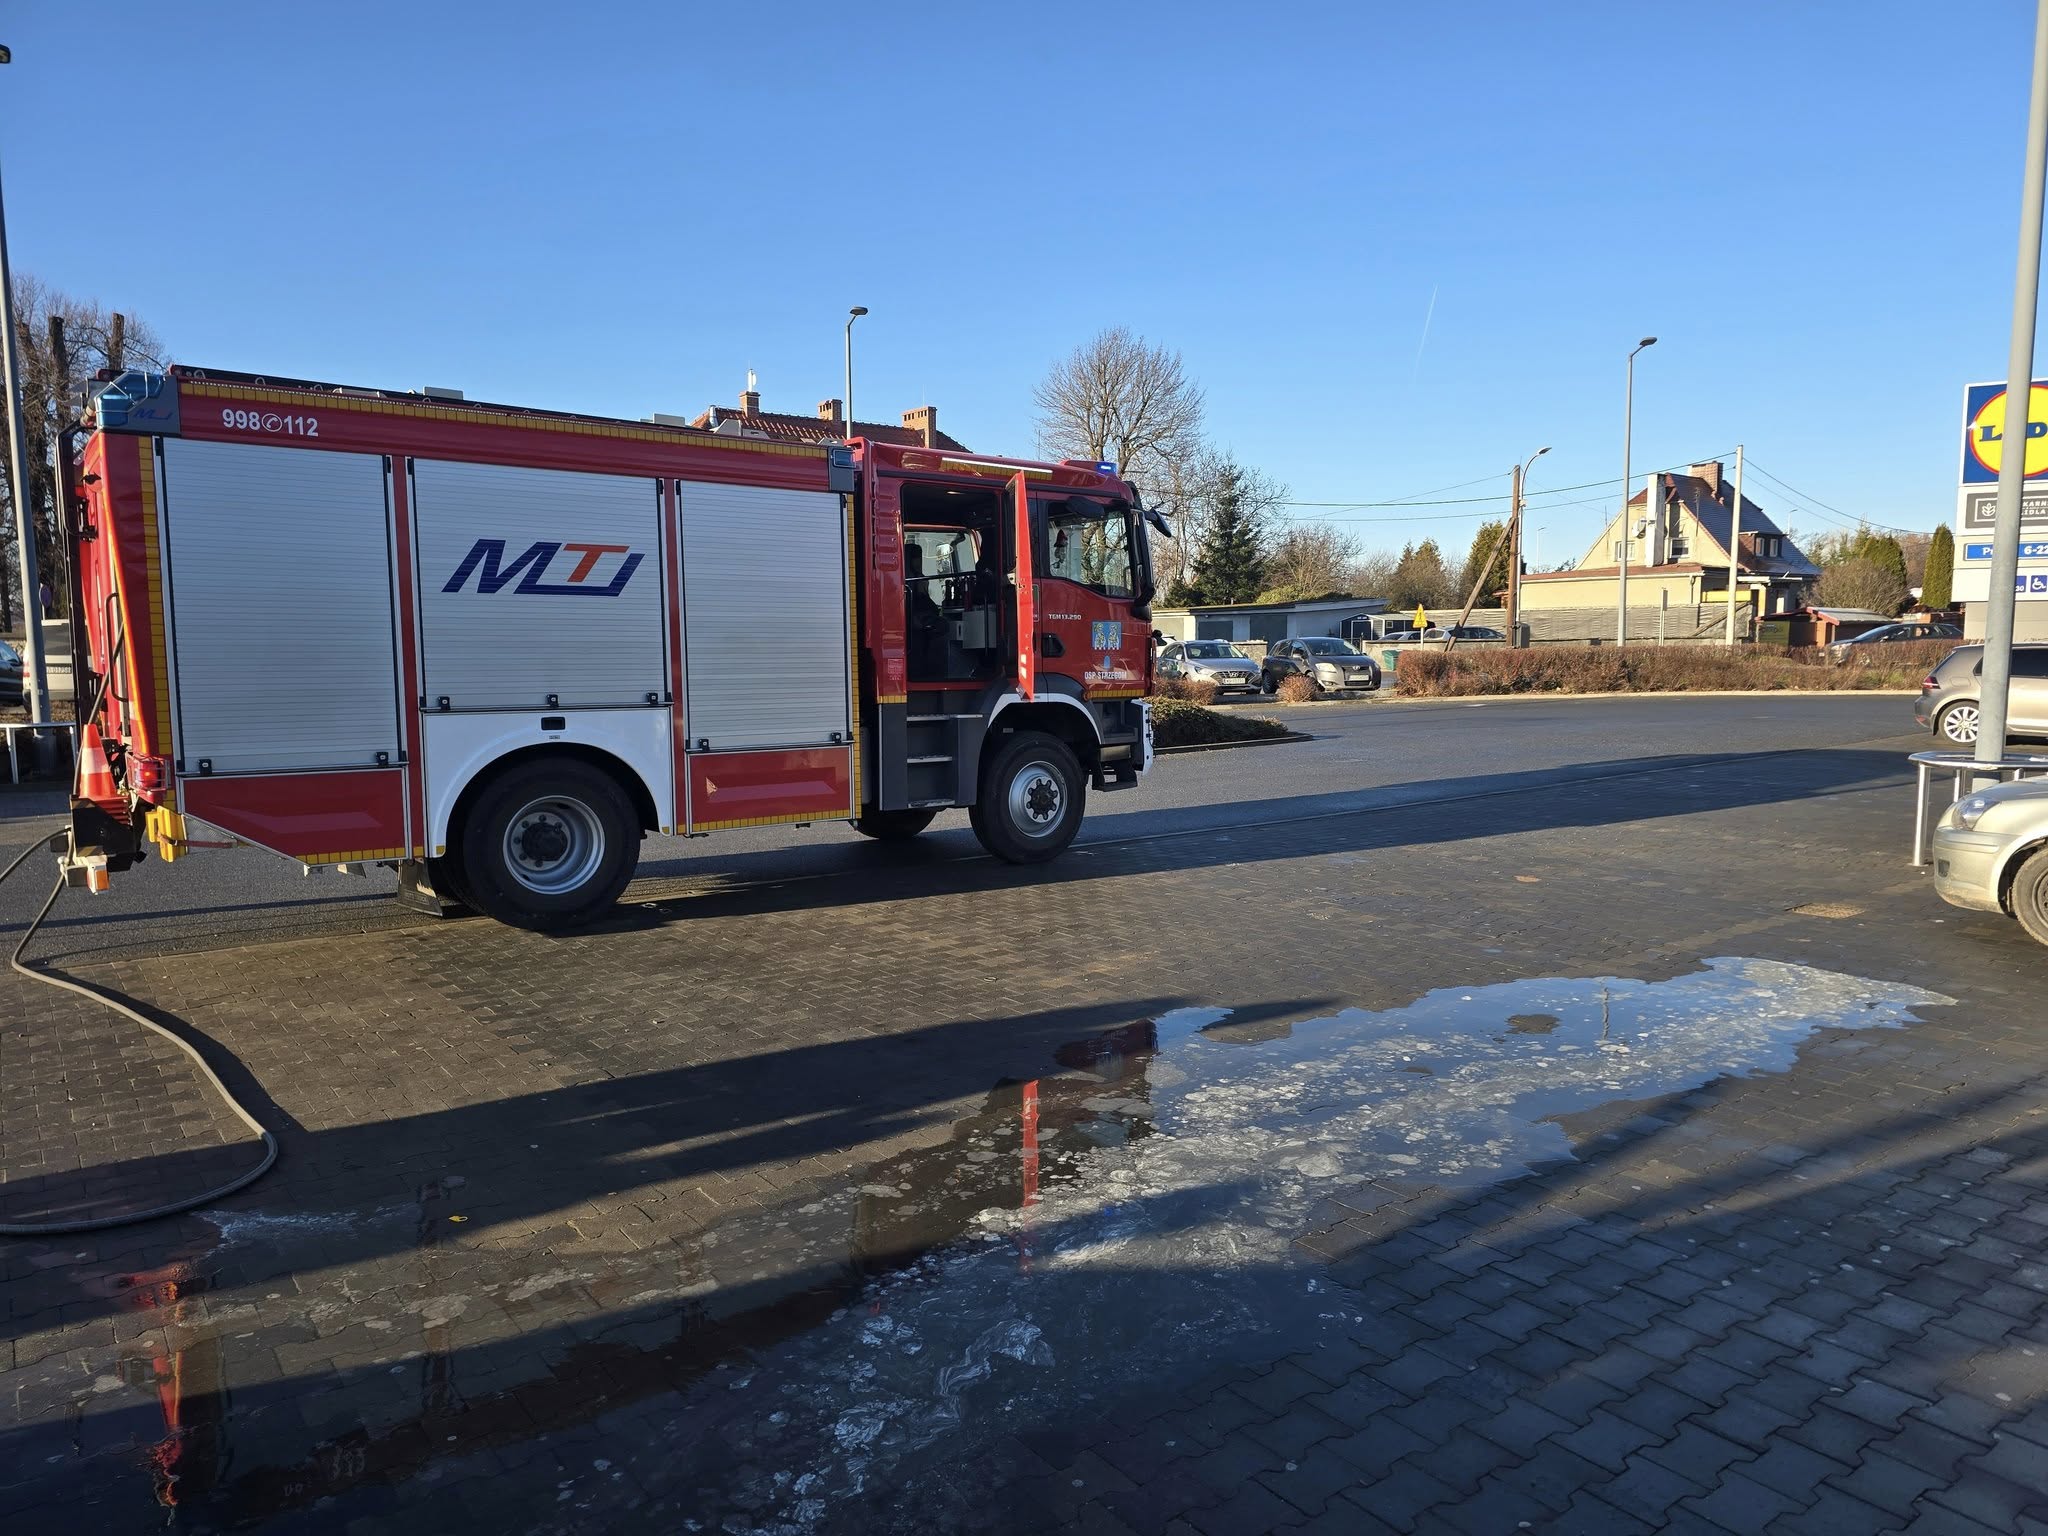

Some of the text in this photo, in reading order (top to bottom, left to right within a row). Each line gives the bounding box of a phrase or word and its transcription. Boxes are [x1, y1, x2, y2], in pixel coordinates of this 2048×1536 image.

[222, 408, 319, 437] 998 112
[1978, 421, 2048, 442] LD
[1084, 671, 1127, 680] OSP STRZEGOM
